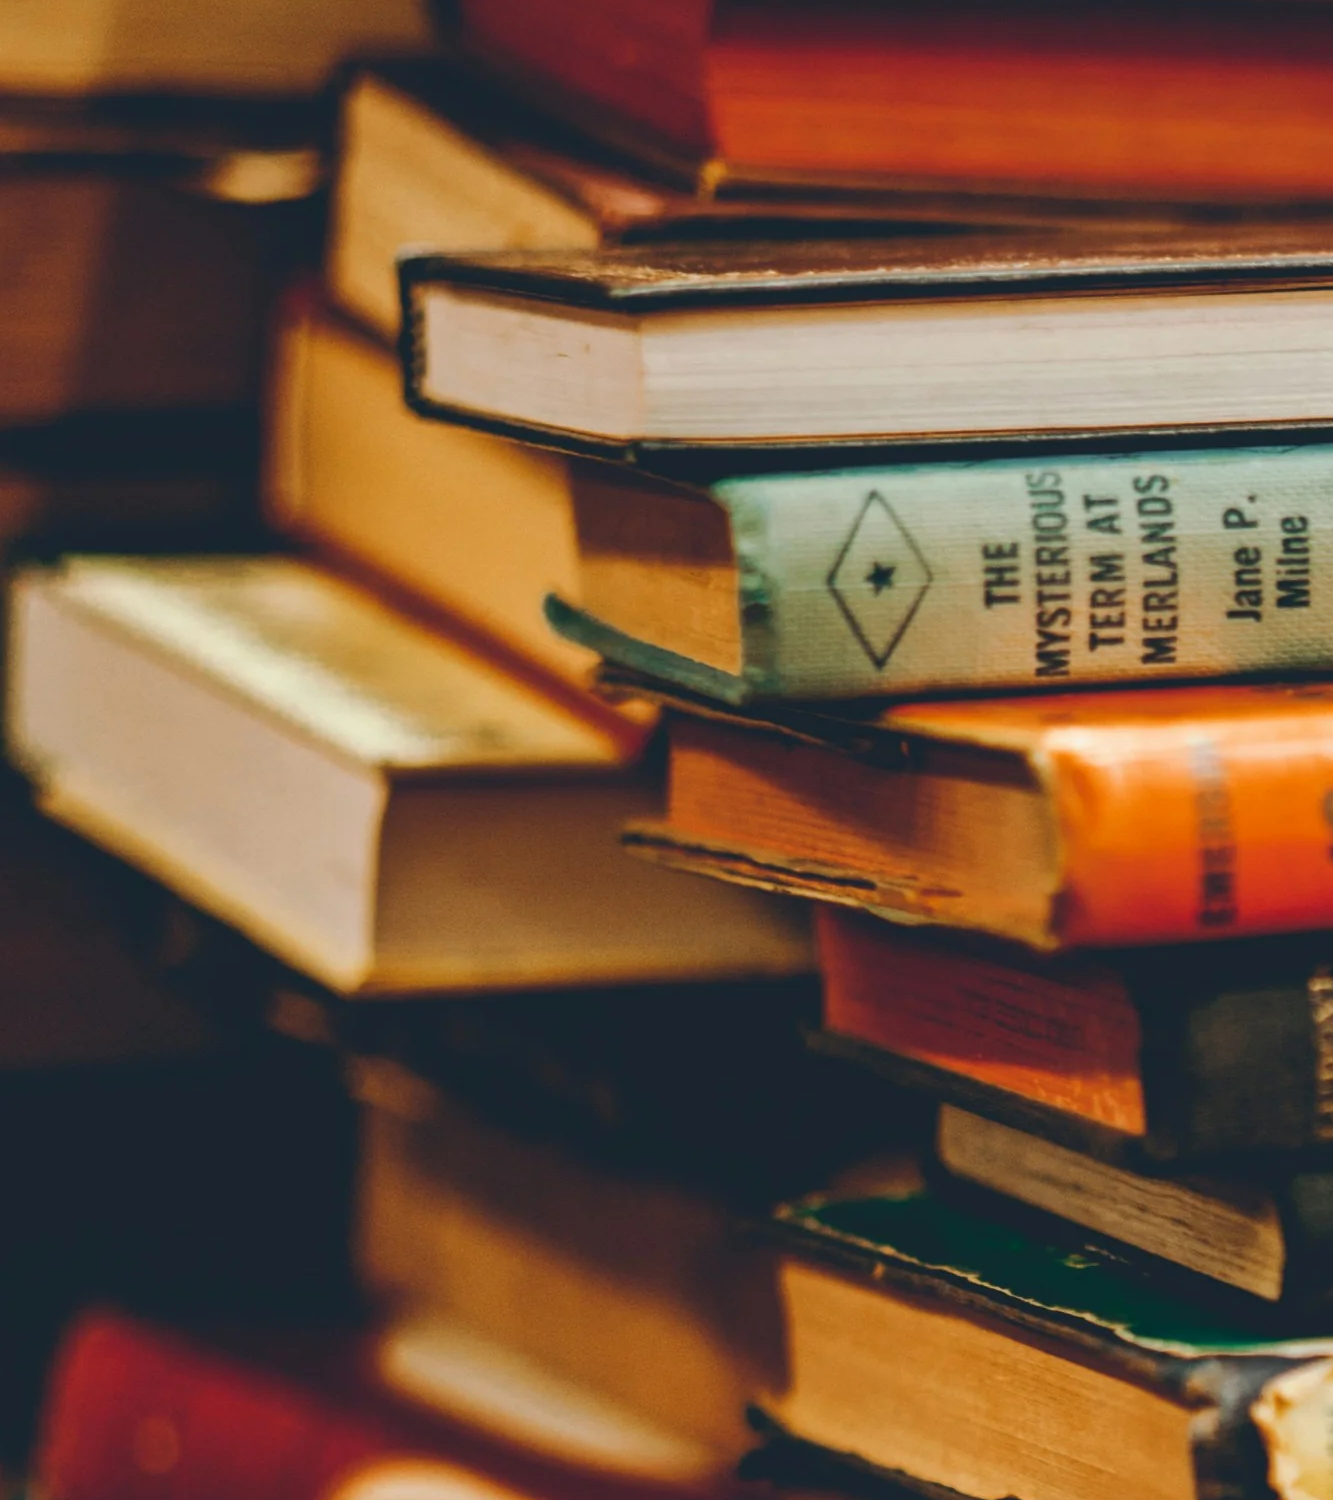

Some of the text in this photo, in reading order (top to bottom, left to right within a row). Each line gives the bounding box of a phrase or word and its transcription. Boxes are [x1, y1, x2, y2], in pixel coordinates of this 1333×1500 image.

[985, 542, 1020, 610] THE
[1025, 468, 1072, 679] MYSTERIOUS
[1083, 493, 1126, 653] TERM AT
[1134, 473, 1179, 667] MERLANDS
[1221, 492, 1264, 624] Jane P.
[1275, 513, 1312, 610] Milne
